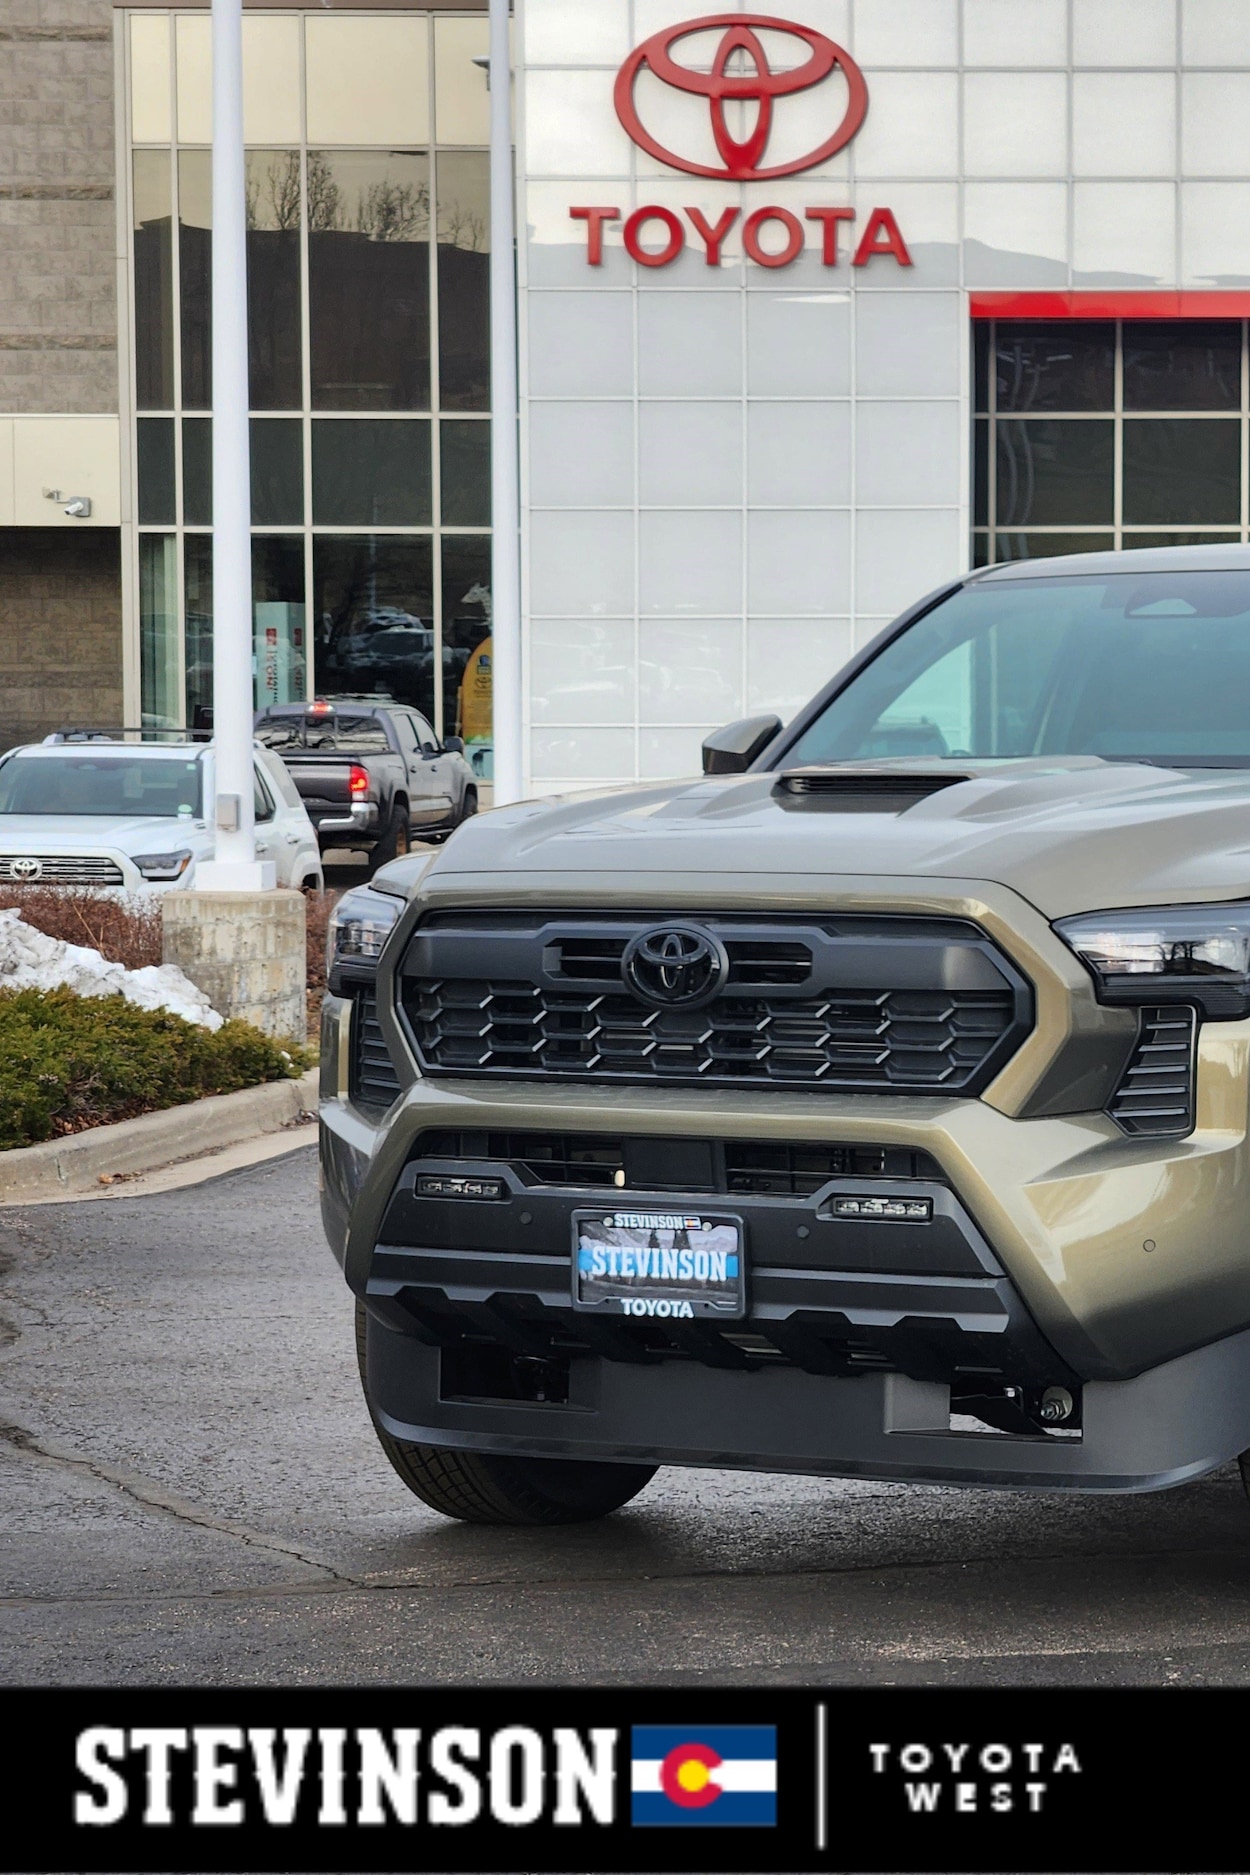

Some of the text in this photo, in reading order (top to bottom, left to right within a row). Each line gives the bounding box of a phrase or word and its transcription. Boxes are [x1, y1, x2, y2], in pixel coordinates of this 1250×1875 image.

[569, 205, 913, 267] TOYOTA
[614, 1213, 684, 1229] STEVINSON
[592, 1246, 728, 1281] STEVINSON
[621, 1298, 694, 1318] TOYOTA
